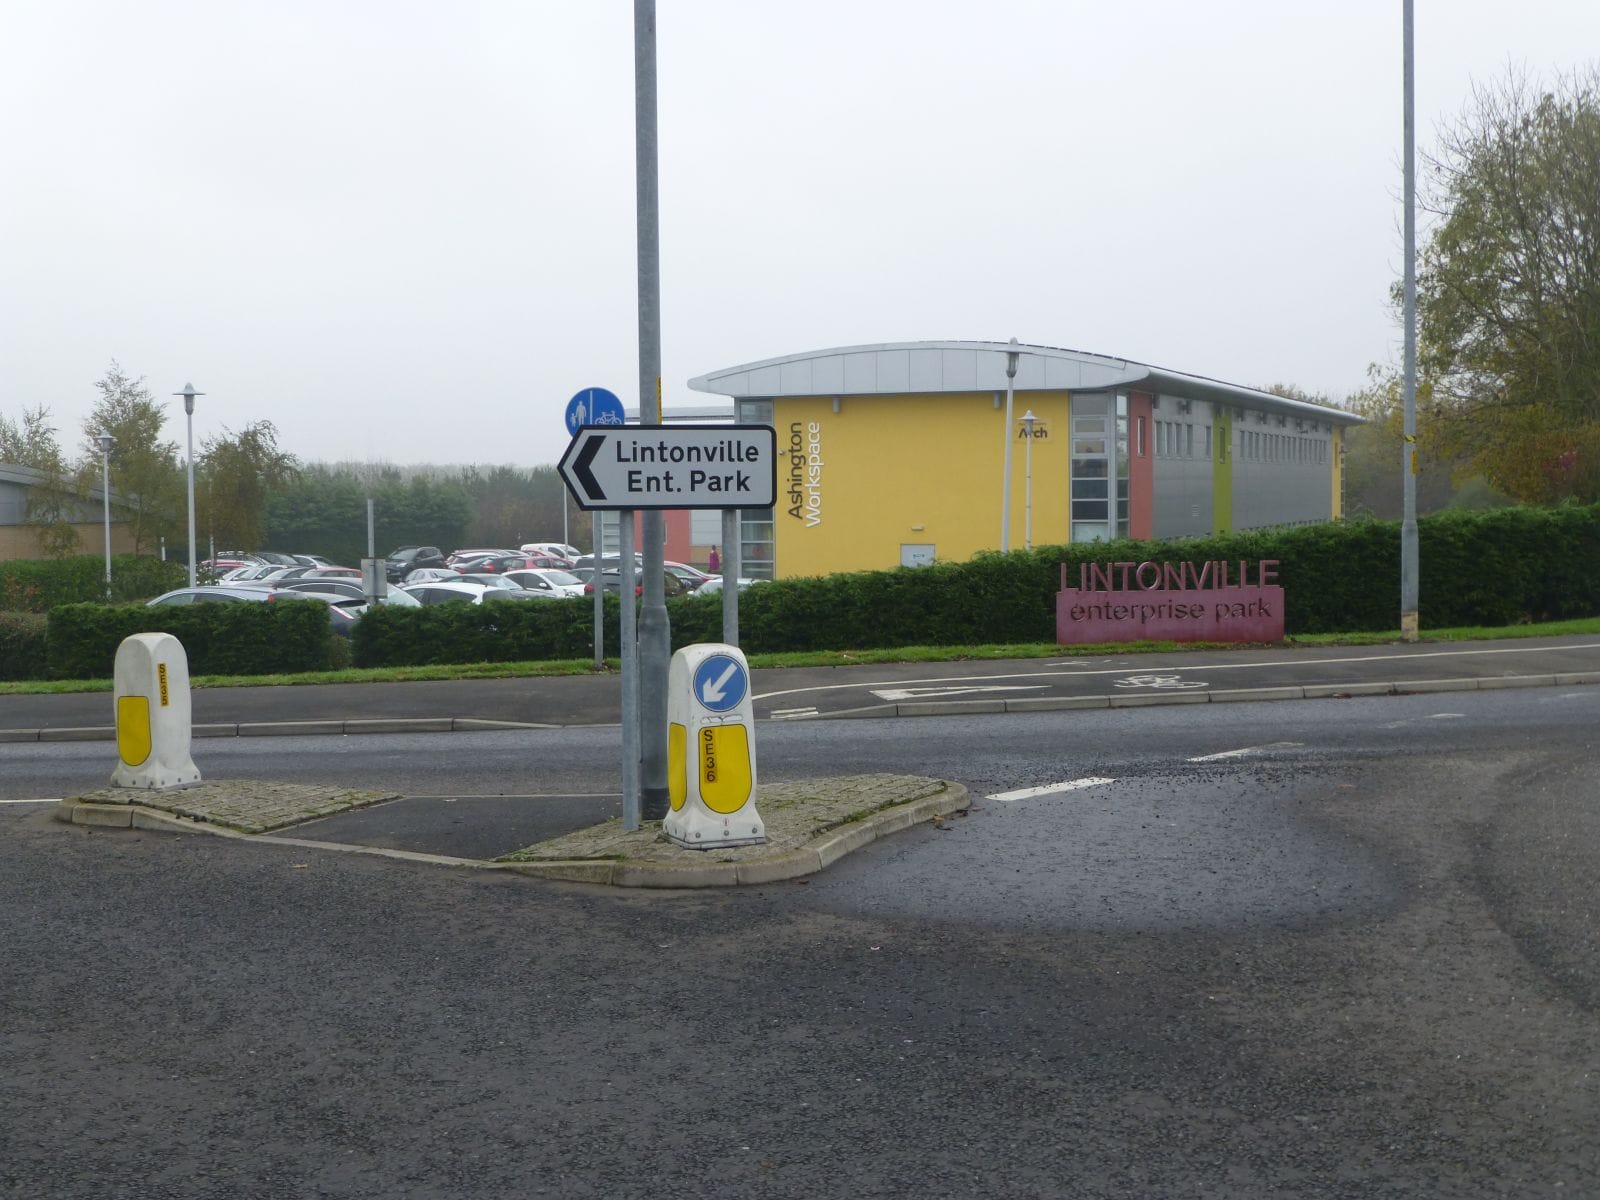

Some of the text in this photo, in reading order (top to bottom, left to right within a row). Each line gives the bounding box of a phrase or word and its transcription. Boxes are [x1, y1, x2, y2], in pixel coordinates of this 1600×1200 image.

[616, 440, 759, 463] Lintonville
[627, 470, 752, 492] Ent. Park
[787, 422, 806, 520] Ashington
[805, 422, 824, 527] Workspace
[1060, 560, 1281, 592] LINTONVILLE
[1070, 597, 1273, 625] enterprise park
[703, 729, 716, 782] SE36
